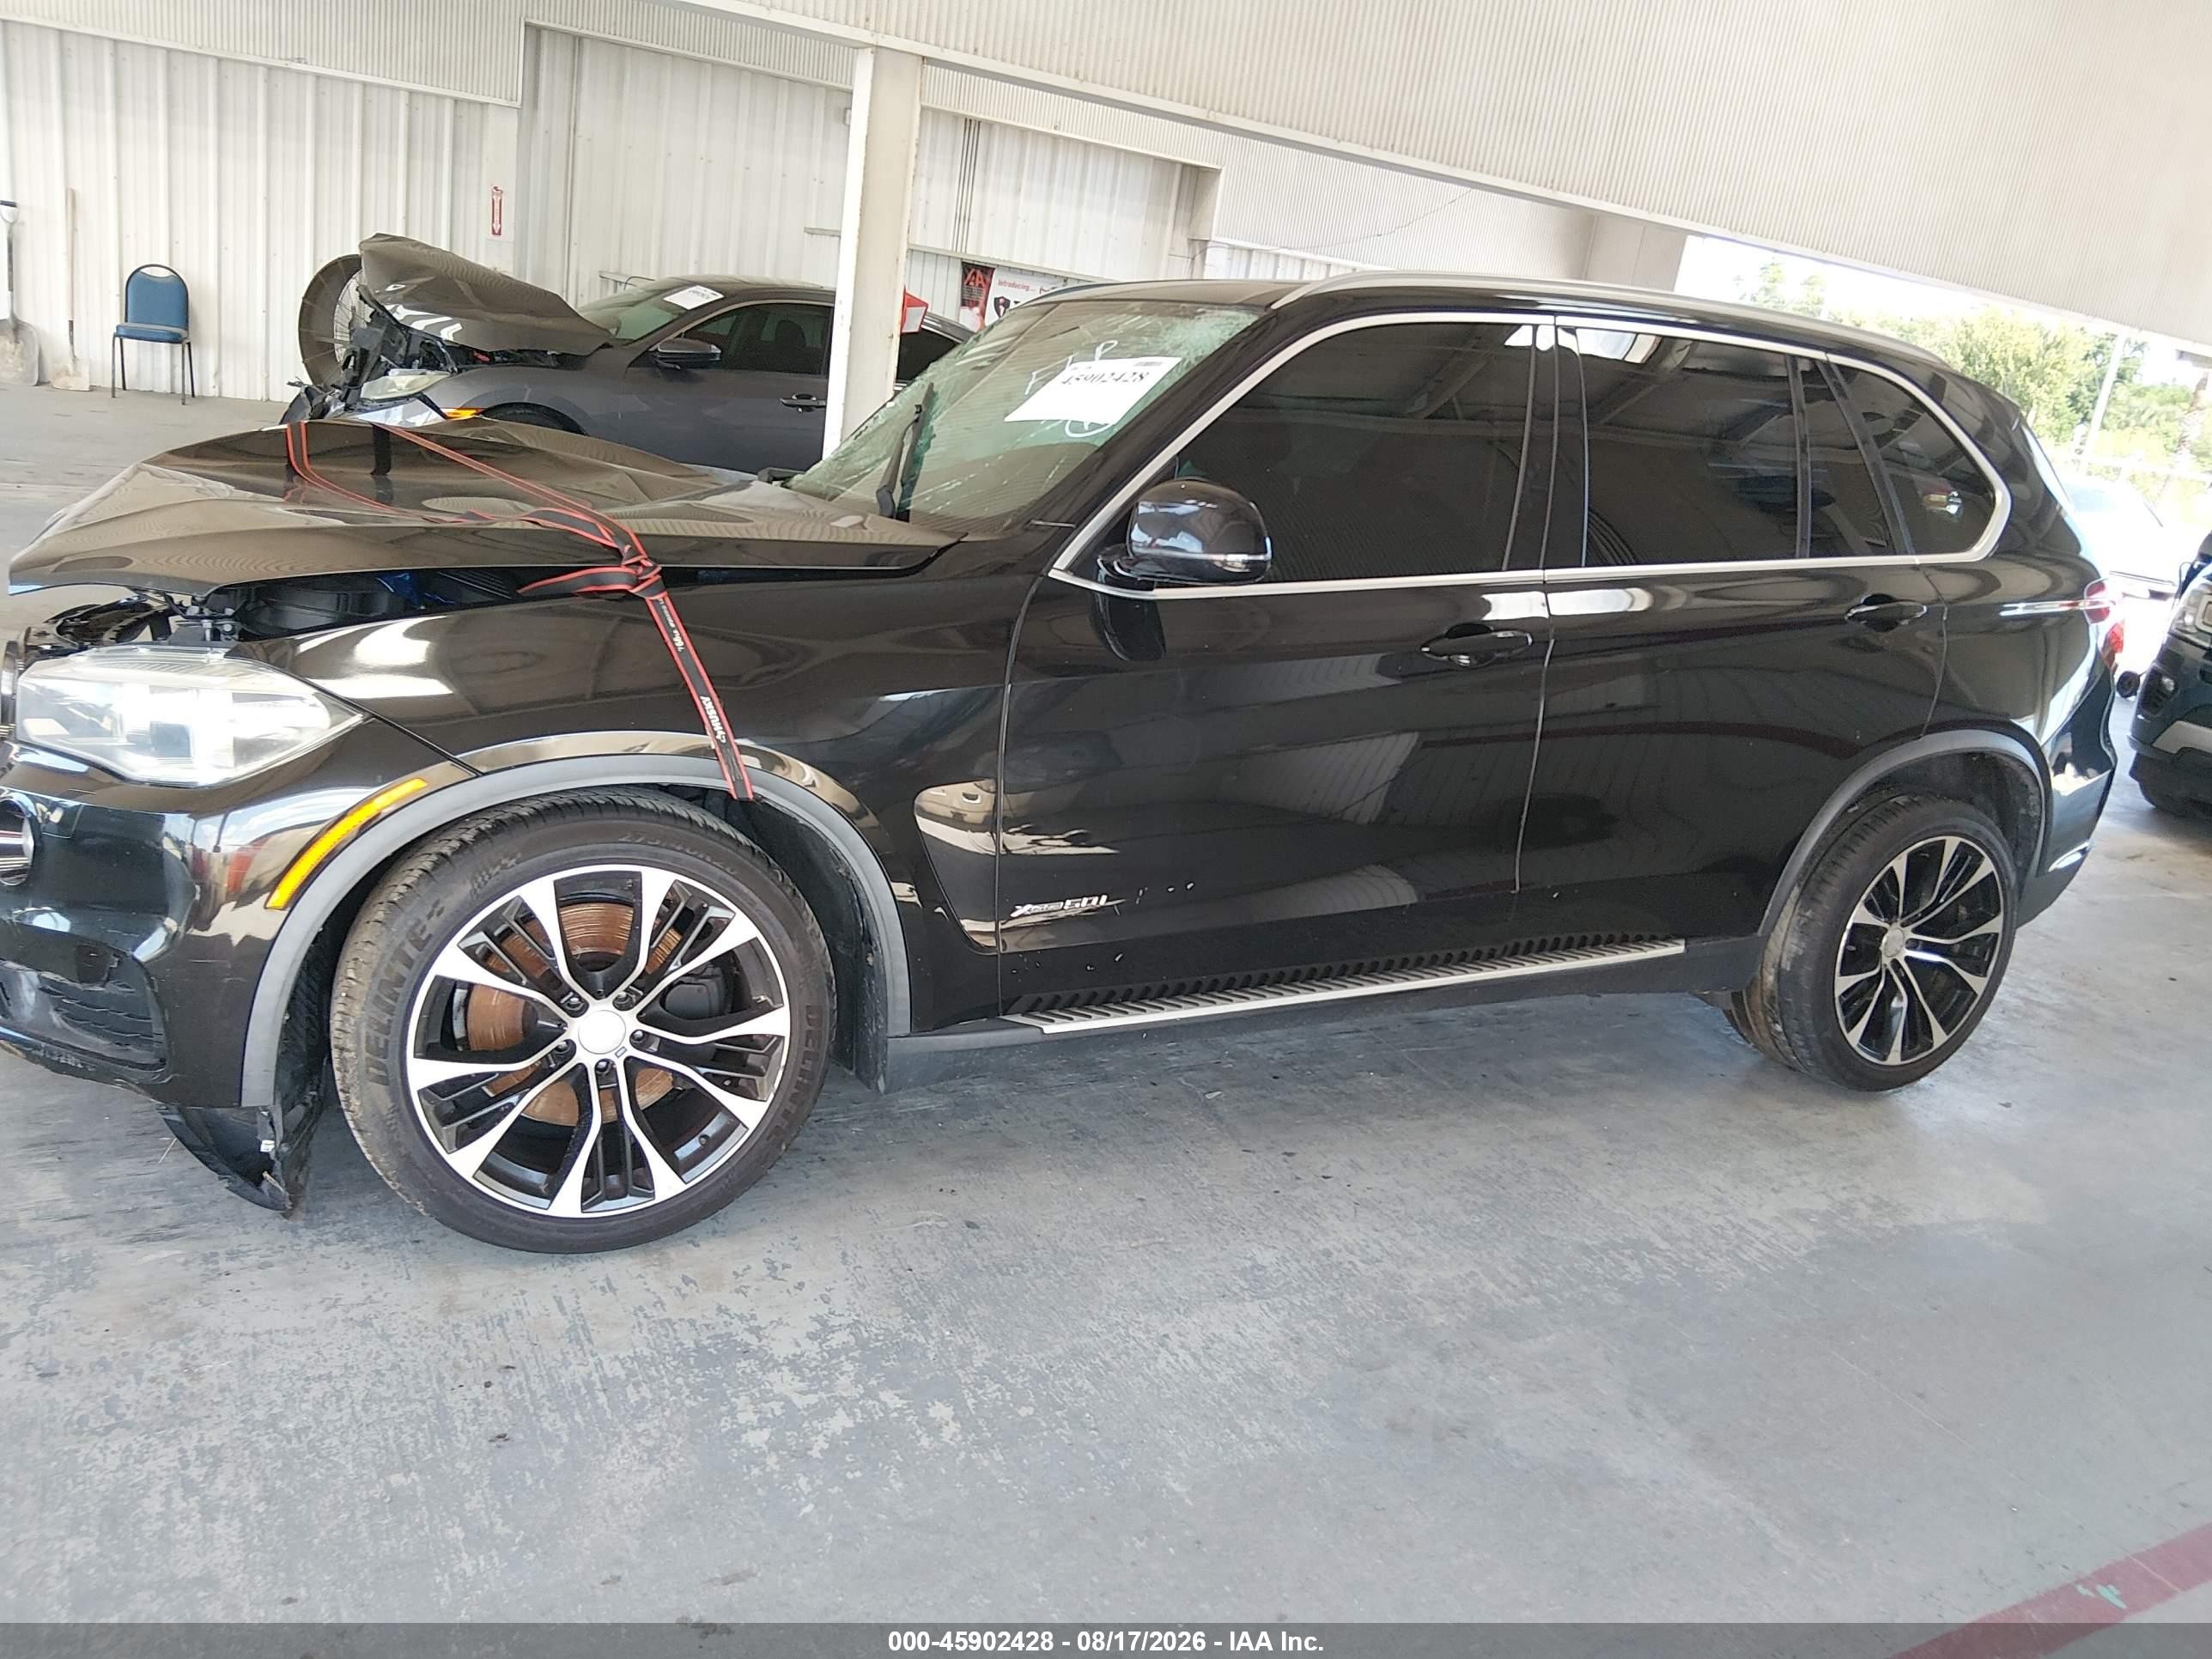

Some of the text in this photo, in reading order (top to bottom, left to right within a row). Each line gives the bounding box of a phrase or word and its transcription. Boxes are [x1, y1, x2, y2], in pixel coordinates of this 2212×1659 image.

[1061, 371, 1150, 386] 45902428
[700, 696, 724, 736] HUSKY
[368, 915, 434, 1086] DELINTE
[767, 1004, 823, 1147] DELINTE
